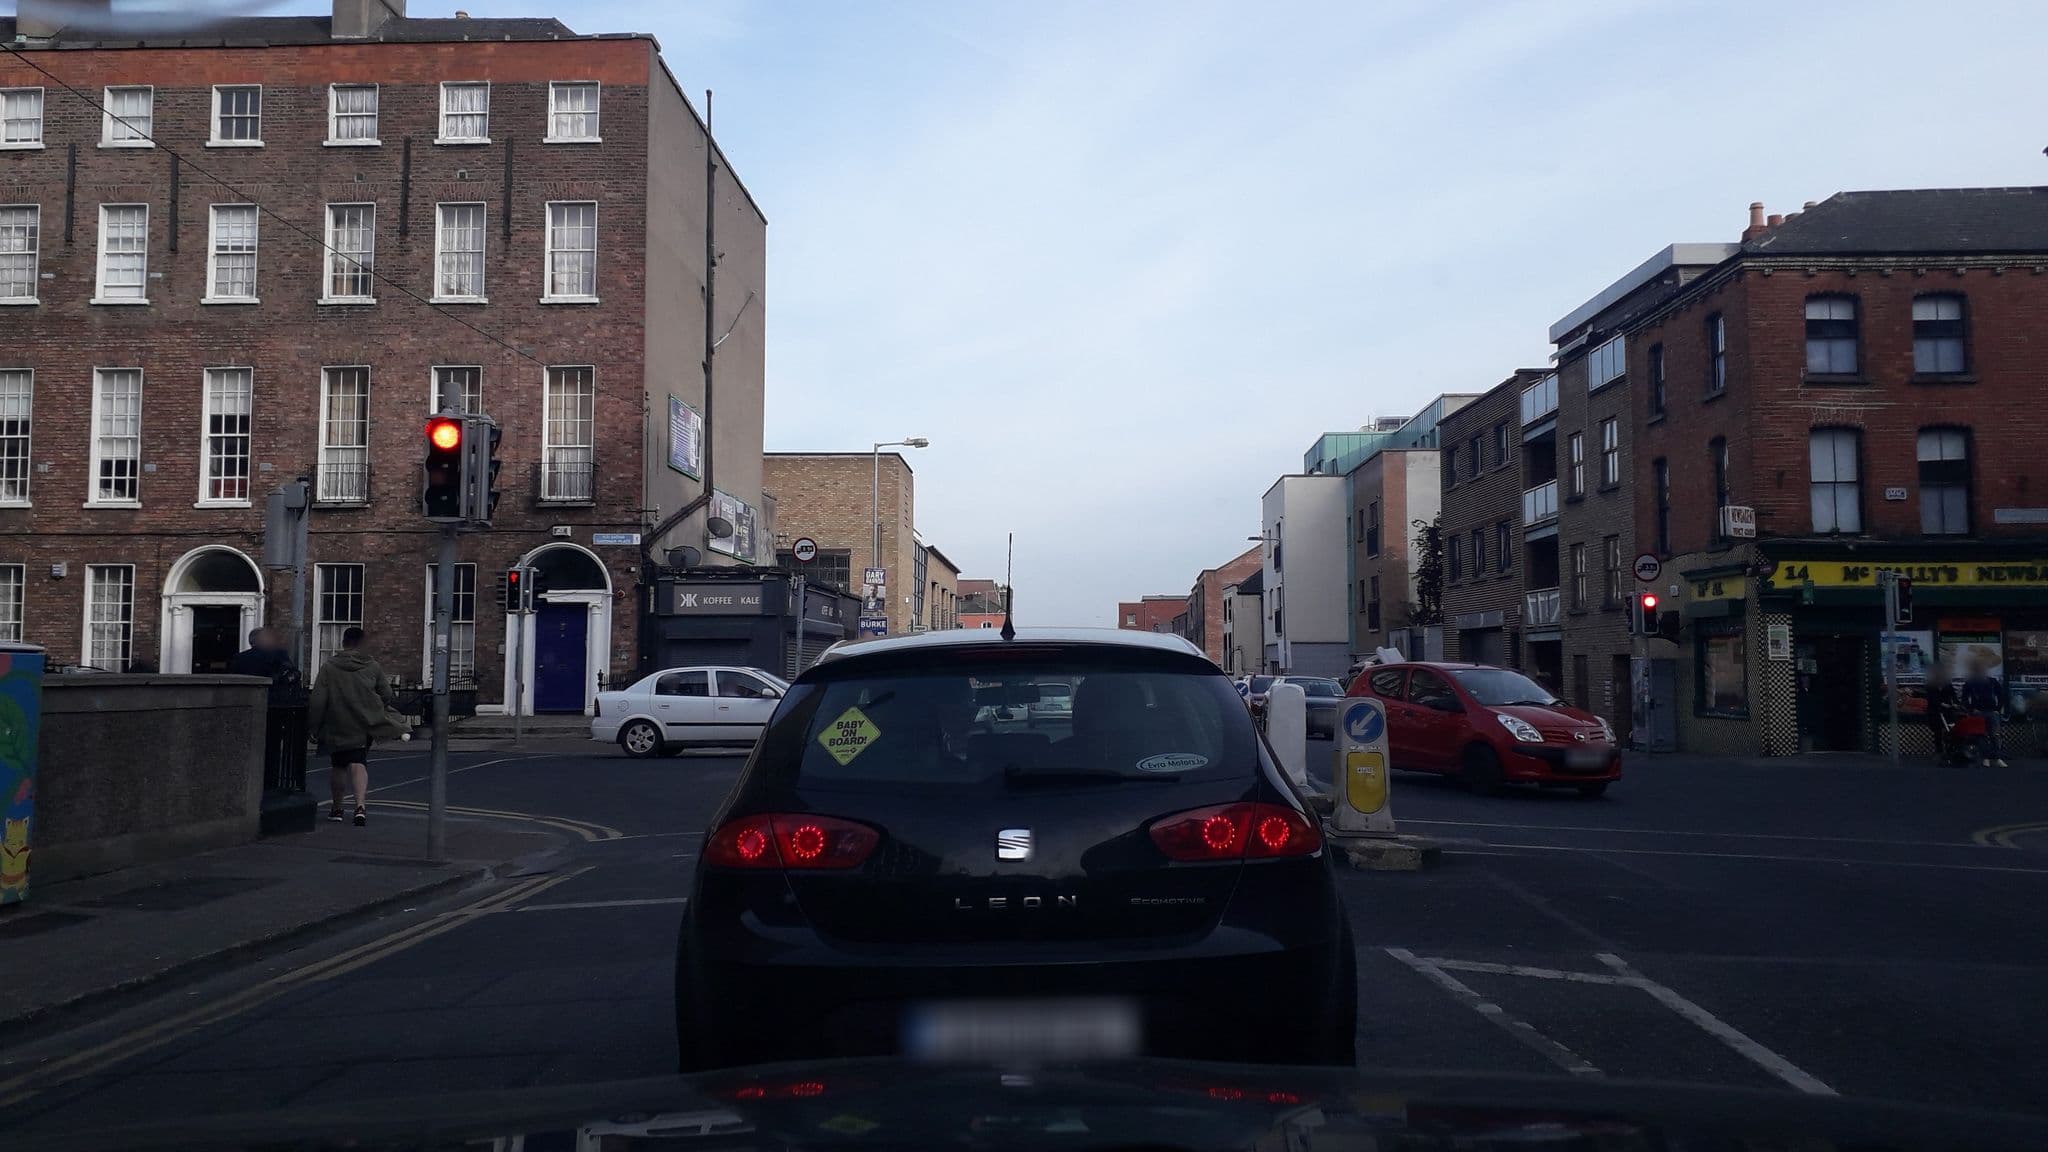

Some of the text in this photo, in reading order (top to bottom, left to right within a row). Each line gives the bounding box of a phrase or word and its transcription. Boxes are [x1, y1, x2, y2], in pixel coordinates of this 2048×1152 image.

[703, 596, 733, 605] KOFFEE
[740, 596, 761, 605] KALE
[860, 620, 887, 629] BURKE
[836, 720, 865, 730] BABY
[841, 729, 857, 737] ON
[828, 737, 868, 747] BOARD!
[953, 894, 1078, 911] LEON
